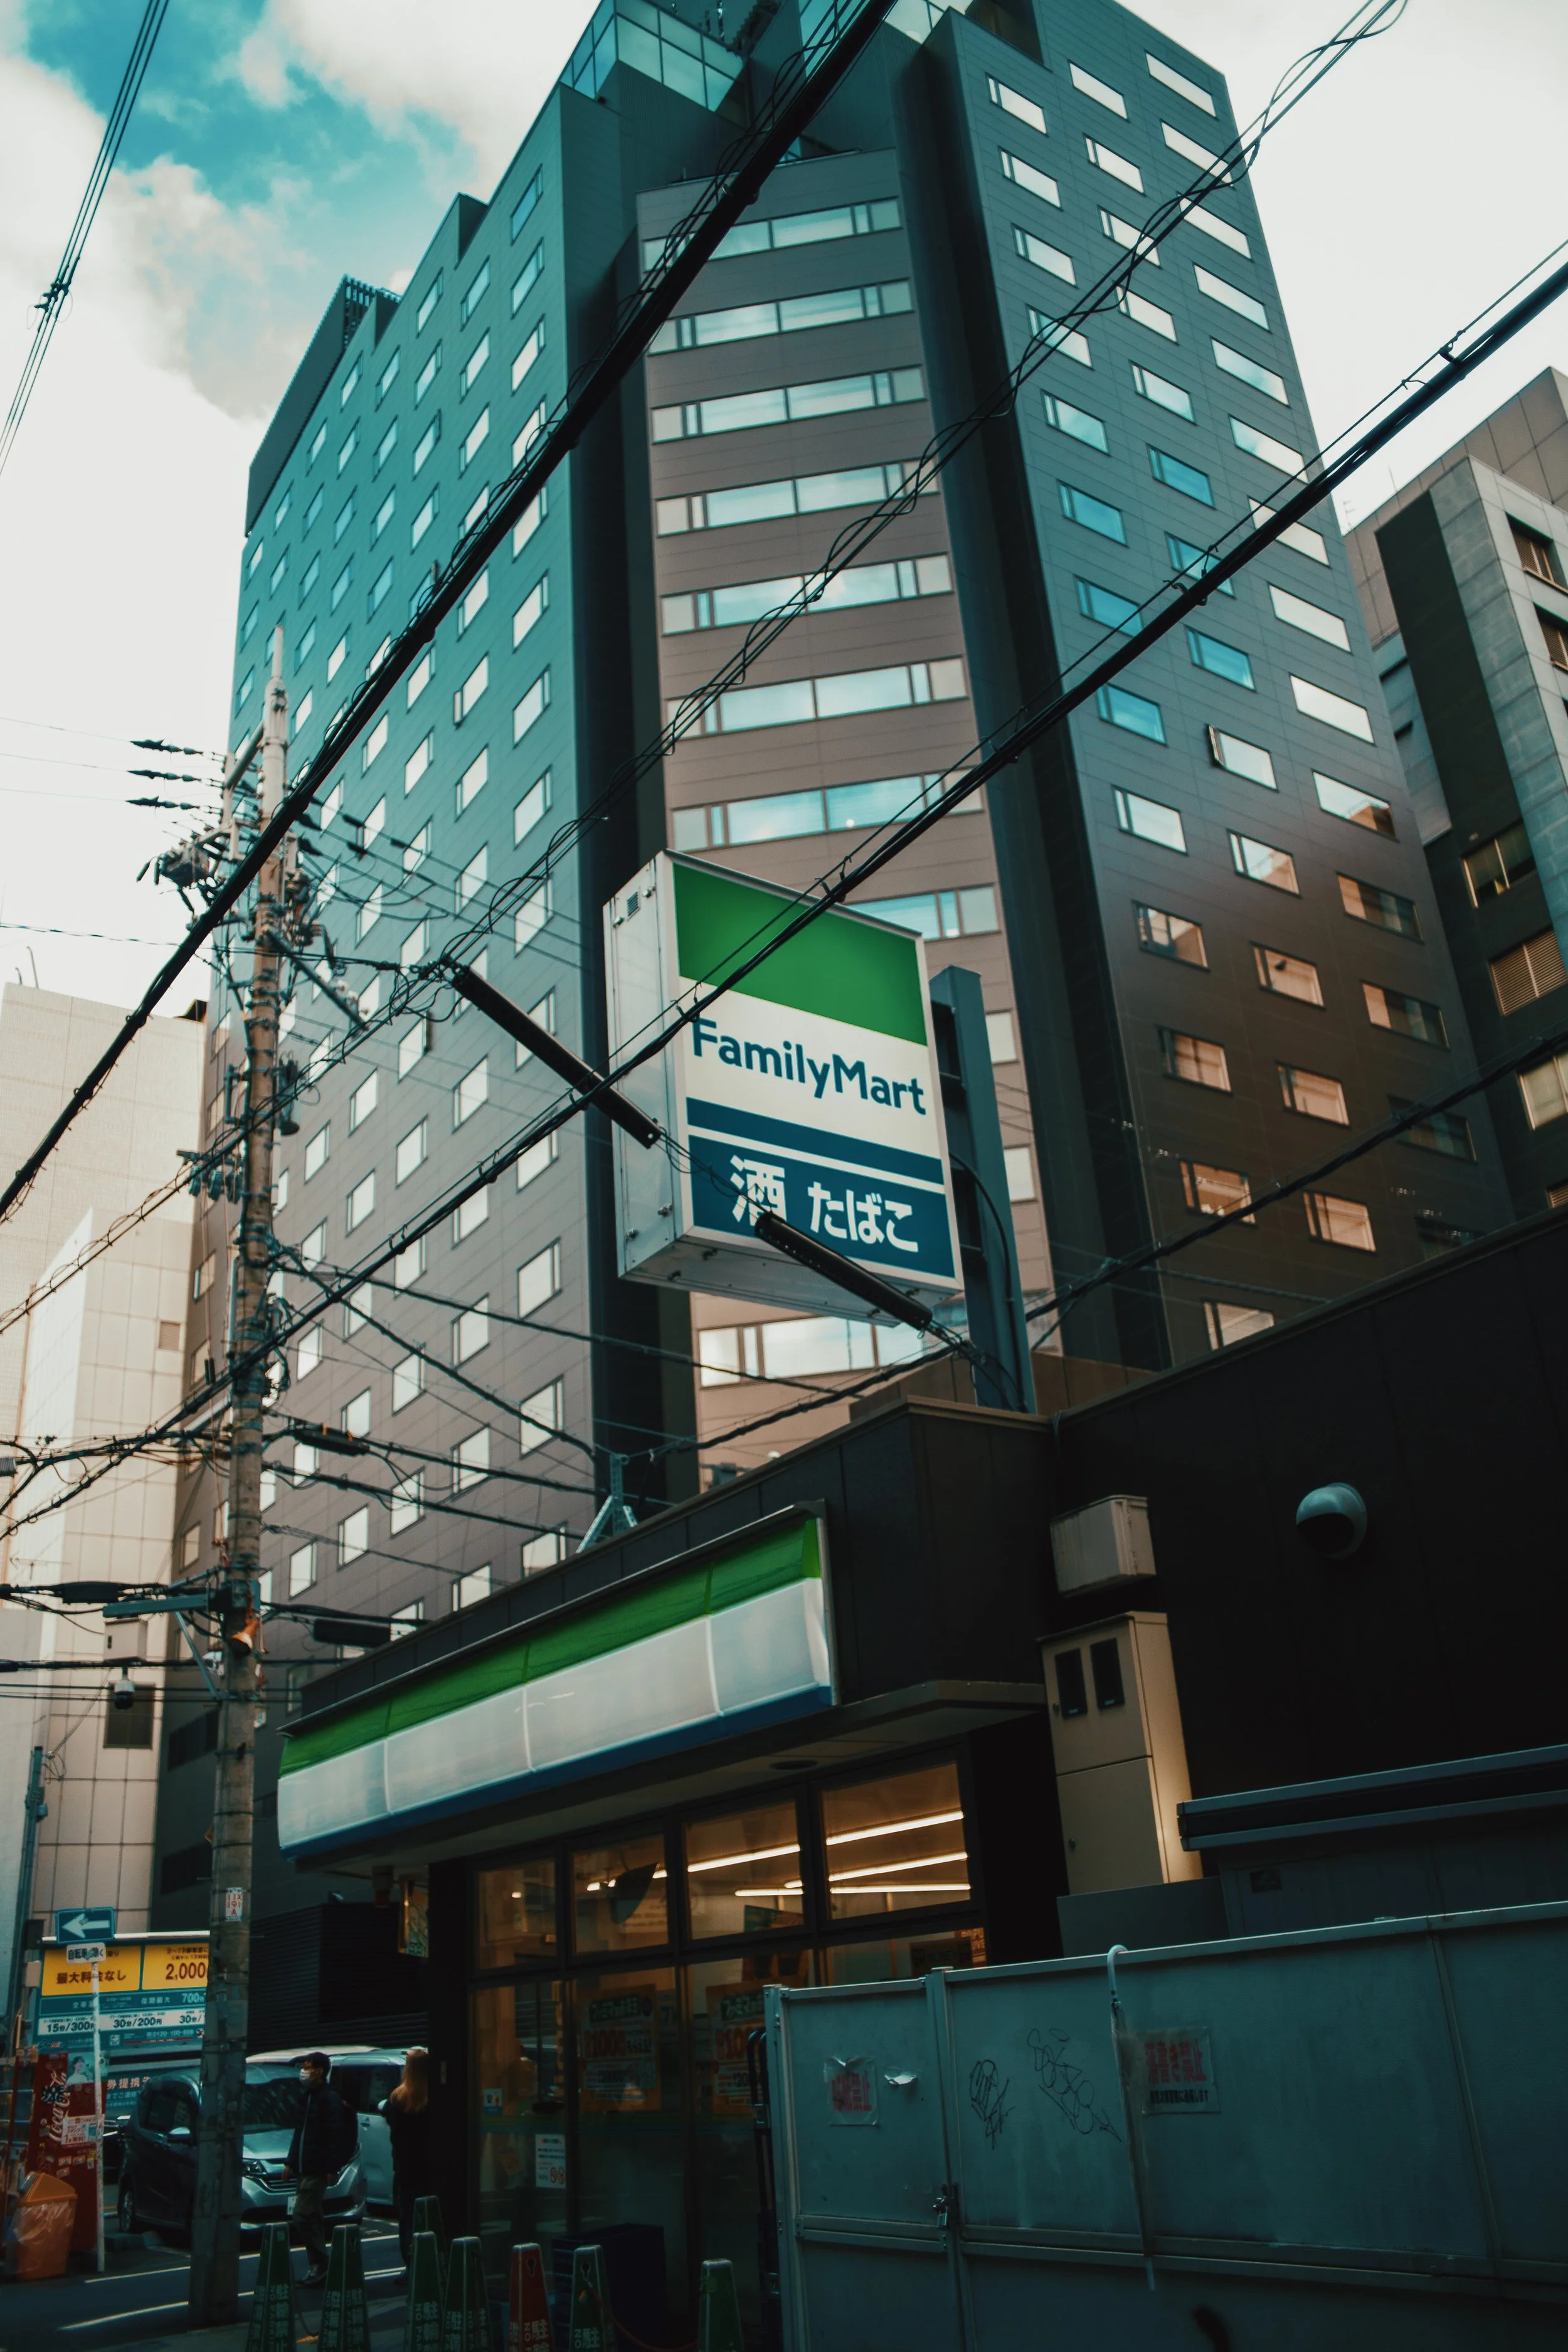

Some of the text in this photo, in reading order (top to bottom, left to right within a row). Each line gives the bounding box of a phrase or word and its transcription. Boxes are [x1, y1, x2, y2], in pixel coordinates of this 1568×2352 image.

[693, 1018, 926, 1115] FamilyMart
[730, 1155, 918, 1253] 酒 たばこ
[166, 1961, 206, 1981] 2,000
[179, 2015, 205, 2024] 30分/
[1145, 2037, 1207, 2084] 落書き禁止
